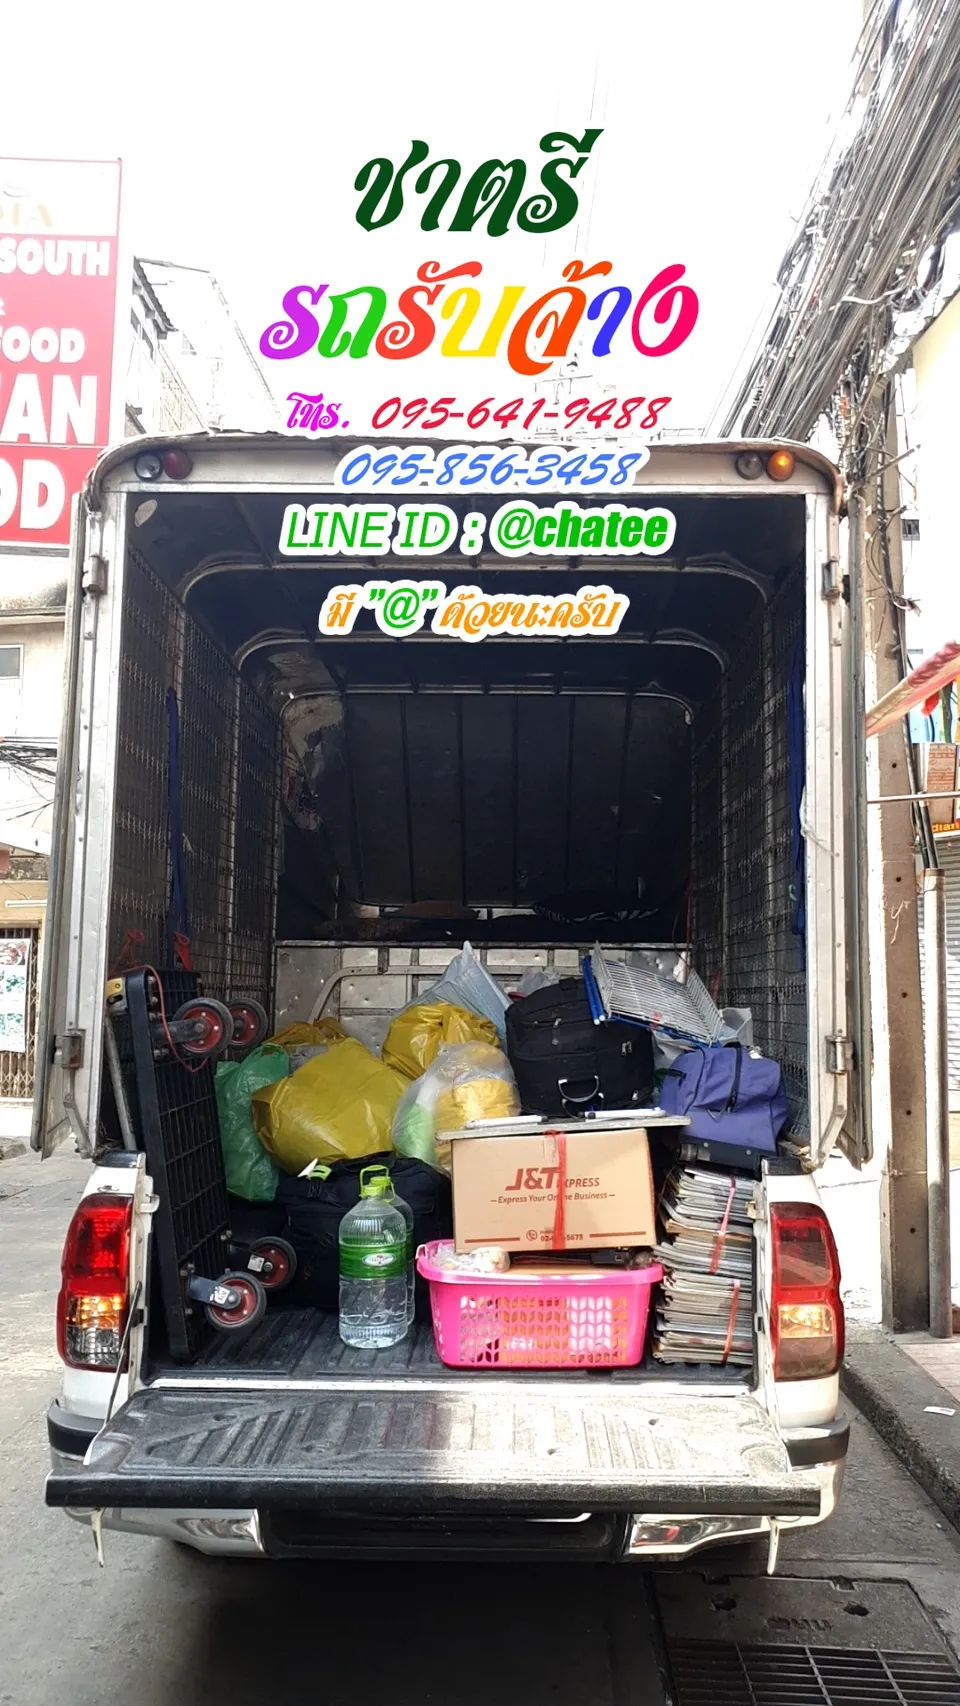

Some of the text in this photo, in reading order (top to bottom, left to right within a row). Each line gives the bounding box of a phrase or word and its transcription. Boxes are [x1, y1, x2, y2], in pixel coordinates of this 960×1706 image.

[0, 237, 110, 276] SOUTH
[0, 325, 85, 363] OOD
[505, 1167, 561, 1191] J&T
[498, 1196, 527, 1205] Express
[574, 1191, 607, 1200] Business
